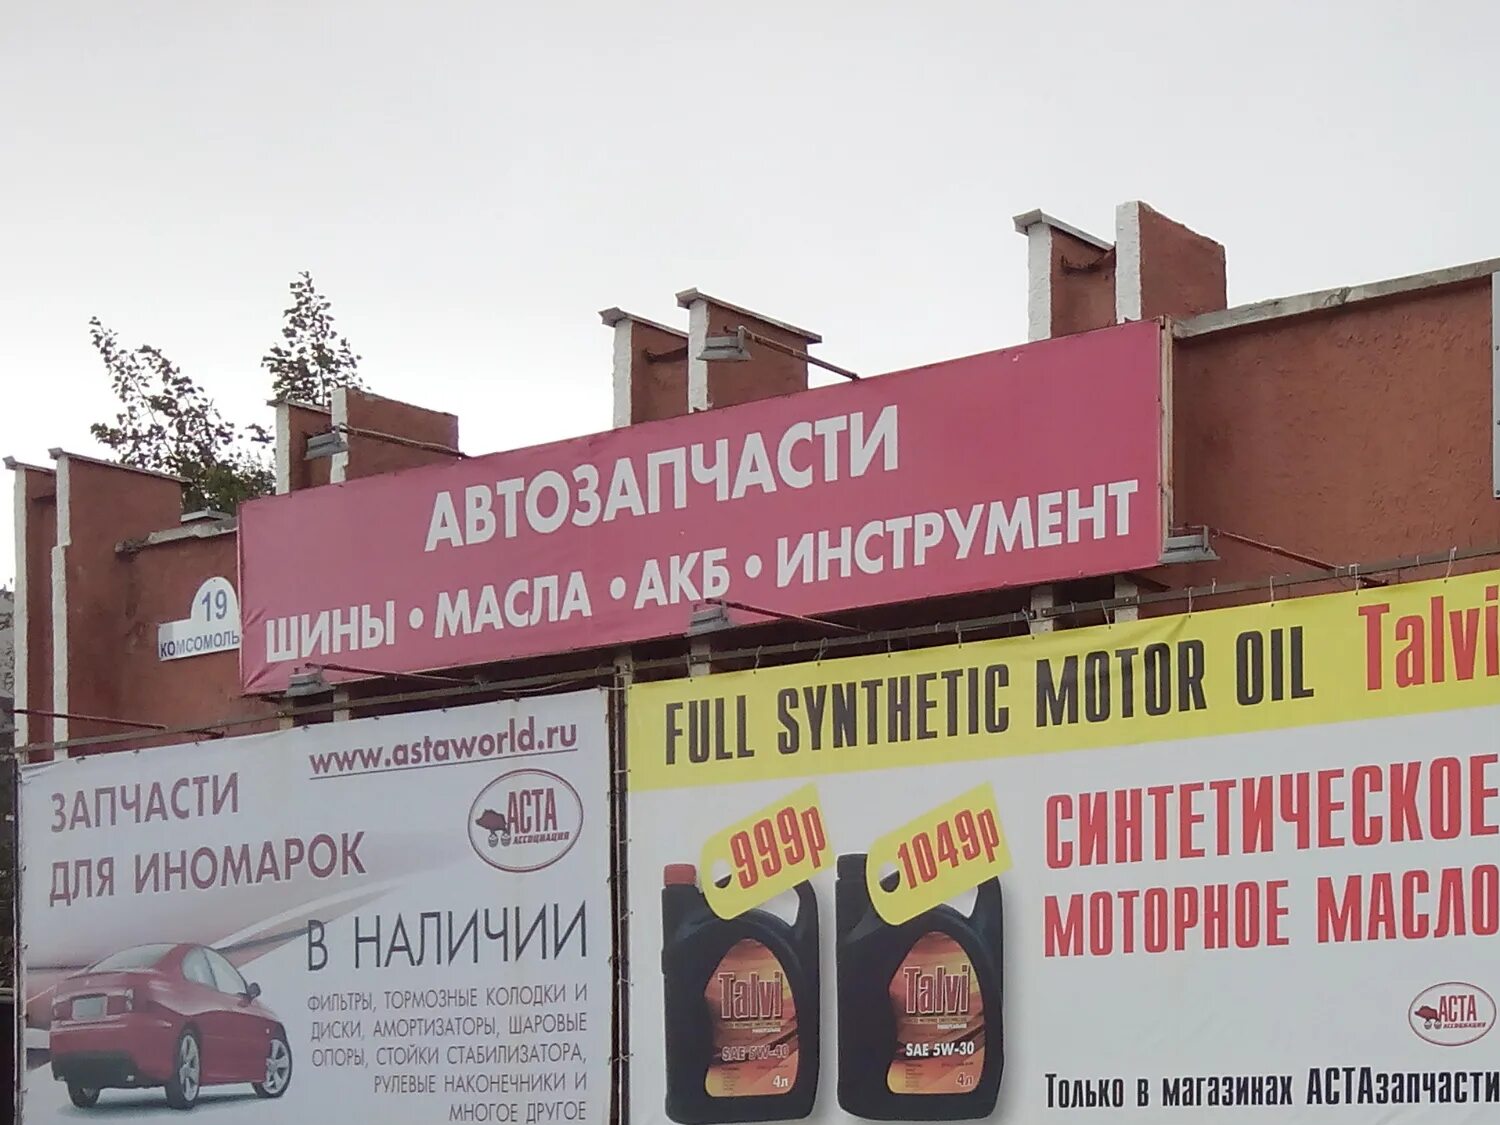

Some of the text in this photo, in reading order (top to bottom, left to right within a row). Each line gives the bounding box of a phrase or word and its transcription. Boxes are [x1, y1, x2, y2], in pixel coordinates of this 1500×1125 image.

[424, 405, 899, 551] АВТОЗАПЧАСТИ
[266, 479, 1138, 663] ШИНЫ МАСЛА АКБ ИНСТРУМЕНТ
[201, 589, 227, 622] 19
[665, 585, 1500, 765] FULL SYNTHETIC MOTOR OIL Talvi
[309, 717, 577, 774] www.astaworld.ru
[51, 772, 240, 833] ЗАПЧАСТИ
[507, 788, 557, 834] АСТА
[1046, 753, 1499, 869] СИНТЕТИЧЕСКОЕ
[50, 832, 366, 906] ДЛЯ ИНОМАРОК
[729, 805, 826, 889] 999р
[898, 807, 999, 889] 1049р
[1044, 864, 1500, 958] МОТОРНОЕ МАСЛО
[307, 901, 587, 971] В НАЛИЧИИ
[308, 983, 588, 1013] ФИЛЬТРЫ, ТОРМОЗНЫЕ КОЛОДКИ И
[718, 971, 783, 1019] Talvi
[904, 965, 970, 1014] Talvi
[1440, 994, 1477, 1022] АСТА
[311, 1012, 587, 1042] ДИСКИ, АМОРТИЗАТОРЫ, ШАРОВЫЕ
[906, 1042, 974, 1056] SAE 5W-30
[312, 1043, 587, 1068] ОПОРЫ, СТОЙКИ СТАБИЛИЗАТОРА,
[722, 1046, 745, 1061] SAE
[374, 1072, 587, 1094] РУЛЕВЫЕ НАКОНЕЧНИКИ И
[773, 1075, 788, 1087] 4л
[1045, 1066, 1500, 1108] Только в магазинах АСТАзапчасти
[449, 1101, 586, 1124] МНОГОЕ ДРУГОЕ
